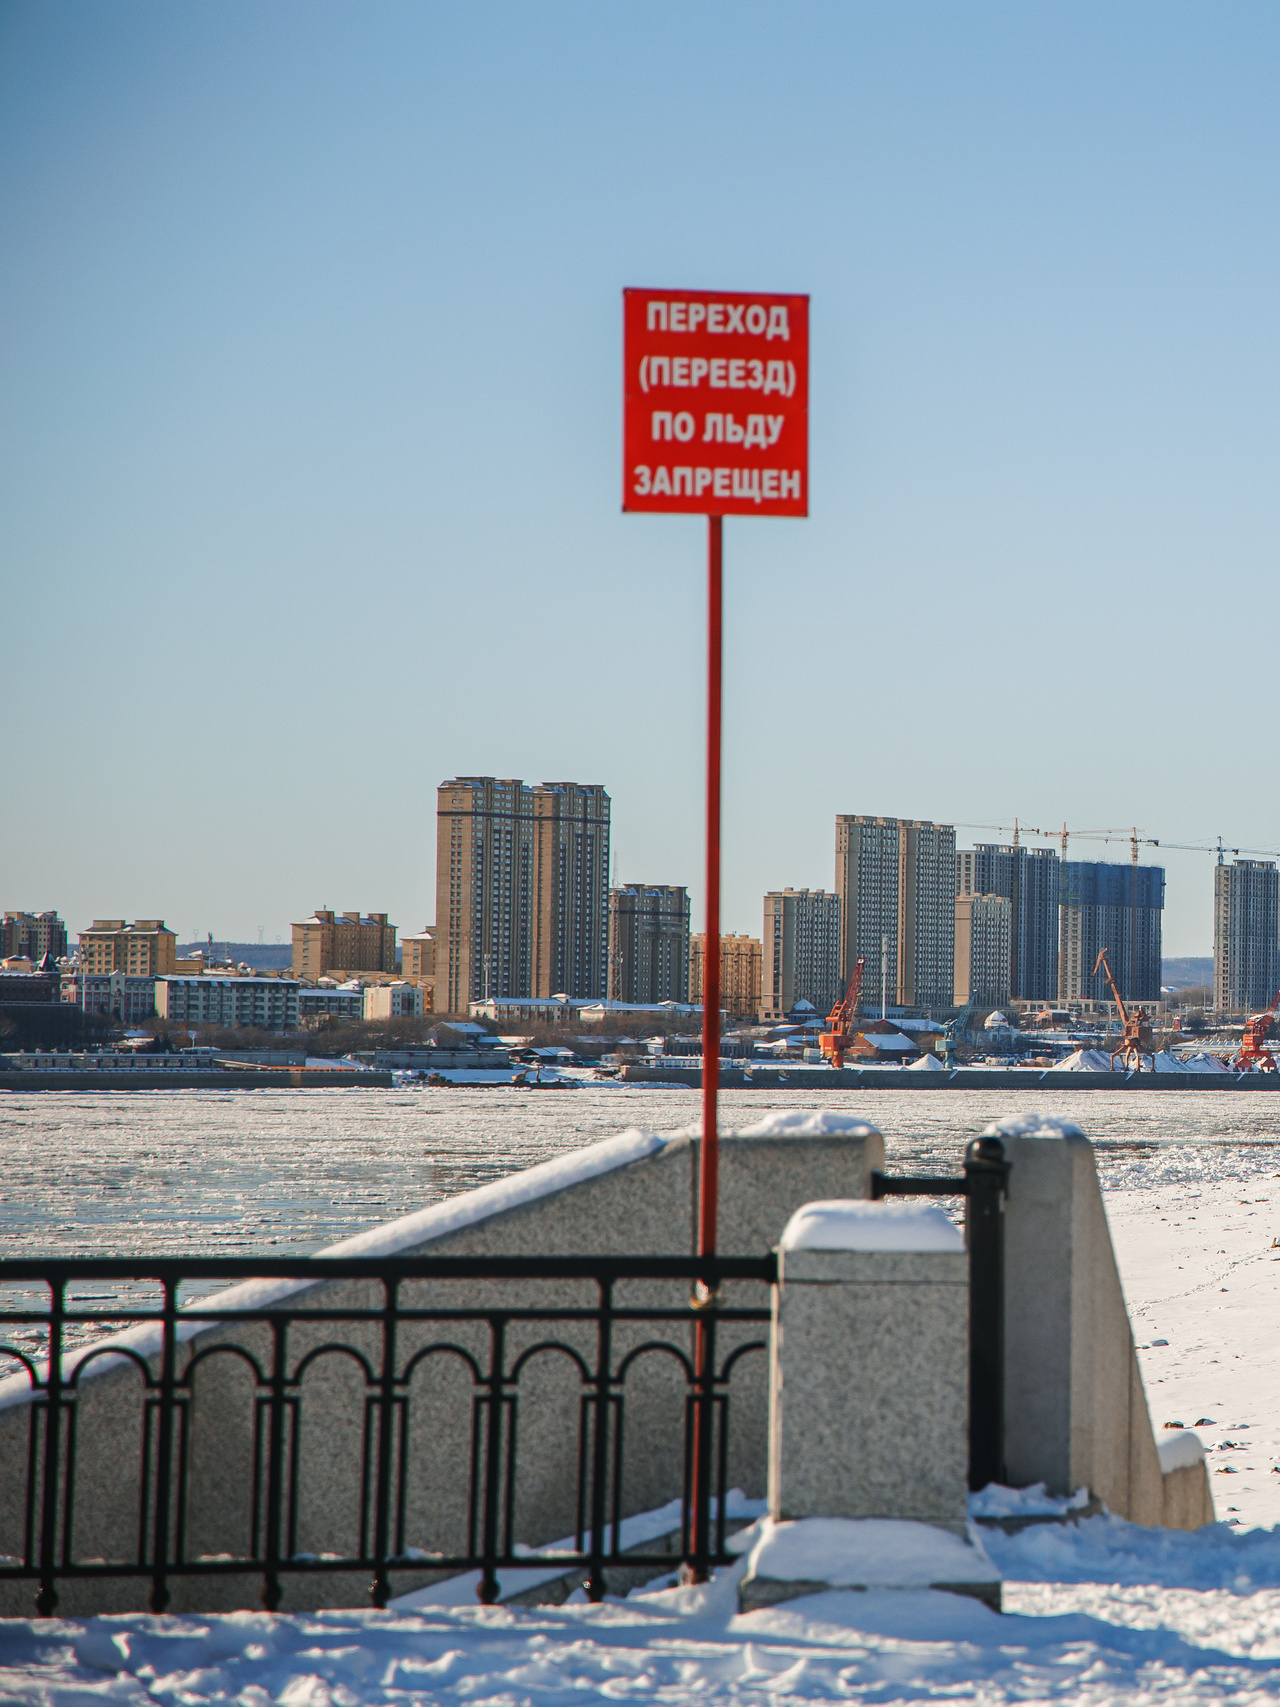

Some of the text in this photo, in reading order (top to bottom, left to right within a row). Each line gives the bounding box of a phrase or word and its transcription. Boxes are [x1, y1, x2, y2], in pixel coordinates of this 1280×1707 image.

[647, 301, 790, 341] ПЕРЕХОД
[639, 355, 796, 398] (ПЕРЕЕЗД)
[652, 410, 784, 449] ПО ЛЬДУ
[633, 465, 800, 504] ЗАПРЕЩЕН
